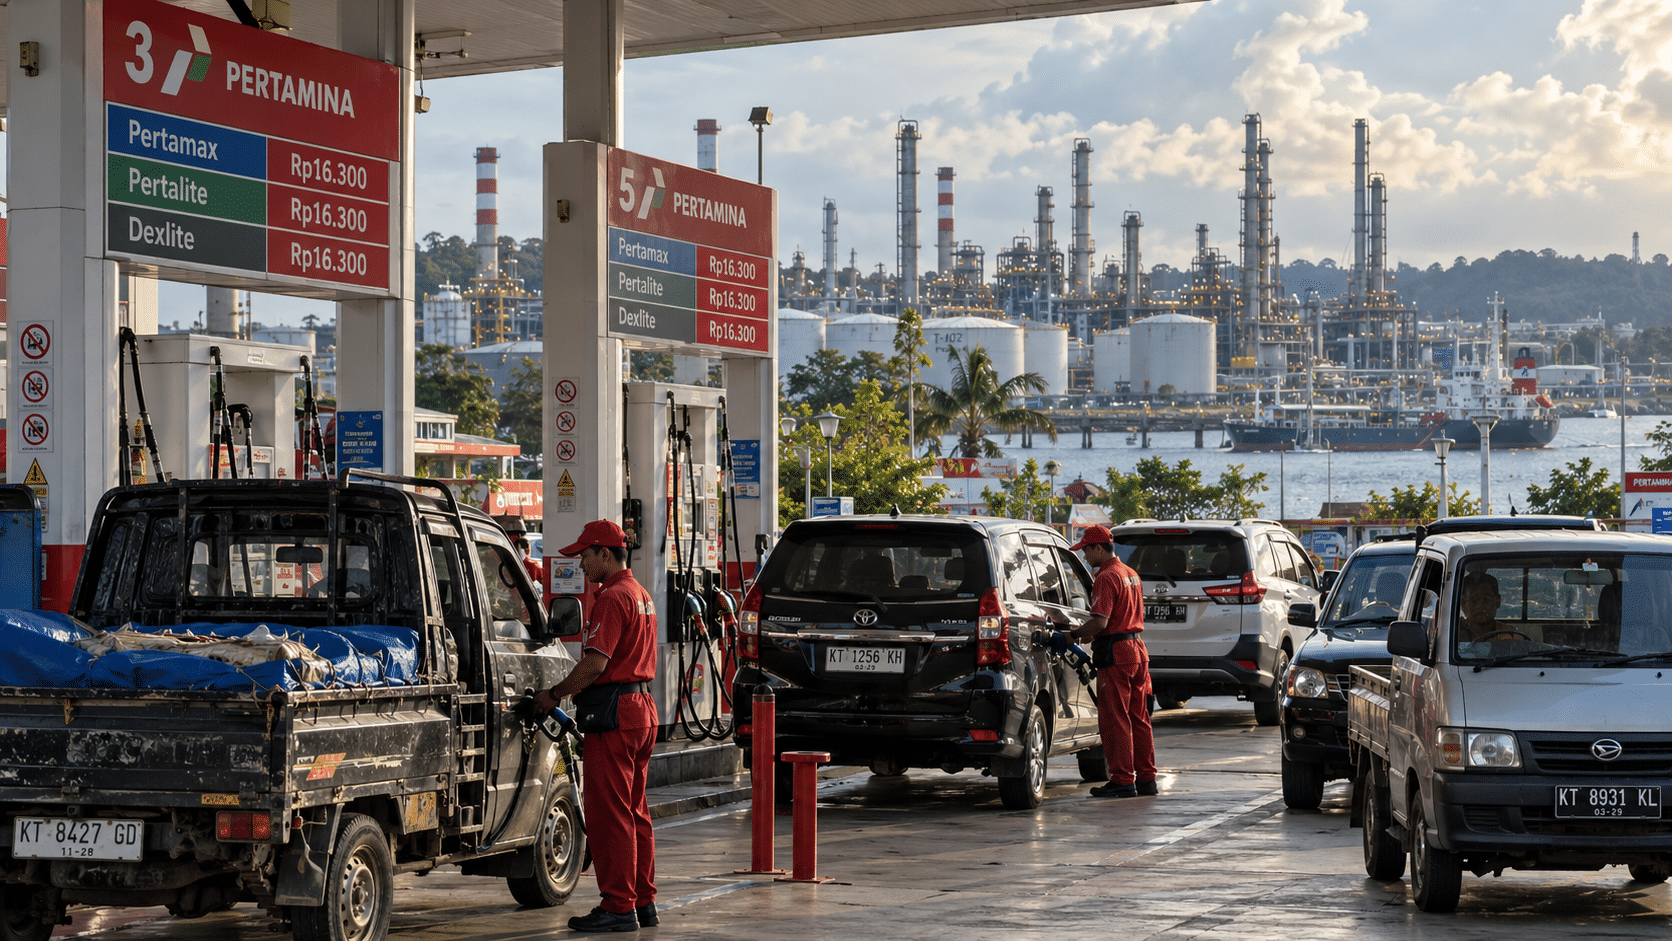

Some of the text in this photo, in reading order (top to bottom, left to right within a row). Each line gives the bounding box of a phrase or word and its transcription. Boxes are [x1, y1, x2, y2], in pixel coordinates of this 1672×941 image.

[125, 20, 355, 118] 3 PERTAMINA
[128, 119, 367, 190] Pertamax Rp16.300
[128, 167, 367, 233] Pertalite Rp16.300
[619, 167, 747, 228] 5 PERTAMINA
[128, 216, 367, 276] Dexlite Rp16.300
[618, 237, 756, 280] Pertamax Rp16.300
[618, 271, 756, 312] Pertalite Rp16.300
[618, 306, 756, 344] Dexlite Rp16.300
[829, 649, 903, 664] KT 1256 KH
[1559, 788, 1658, 807] KT 8931 KL
[1594, 808, 1623, 816] 03-29
[20, 821, 137, 845] KT 8427 GD
[61, 847, 94, 857] 11-28
